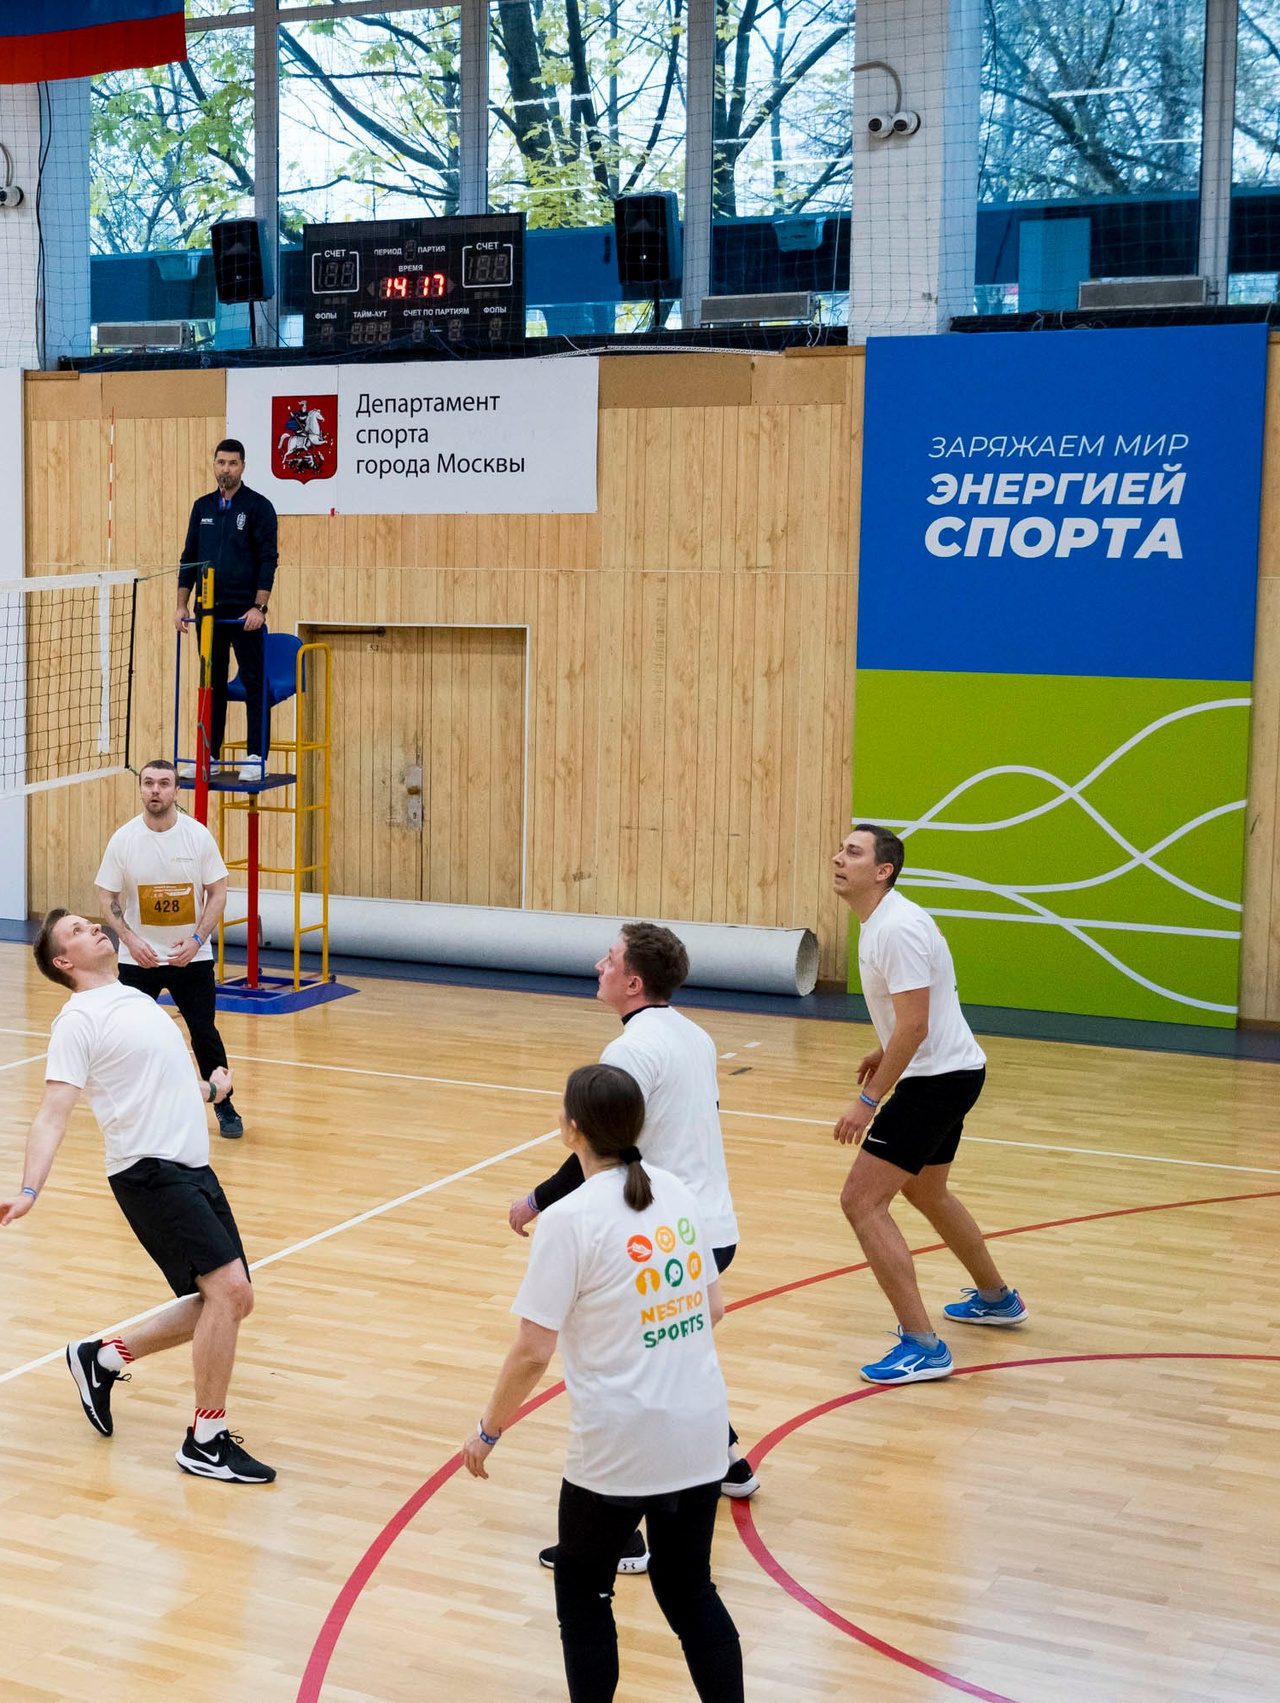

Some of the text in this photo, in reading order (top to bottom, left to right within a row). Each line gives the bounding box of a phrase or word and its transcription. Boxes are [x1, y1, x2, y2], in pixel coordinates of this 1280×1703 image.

[324, 249, 346, 258] СЧЕТ
[373, 245, 446, 256] ПЕРИОД ПАРТИЯ
[476, 241, 499, 250] СЧЕТ
[398, 264, 424, 273] ВРЕМЯ
[353, 309, 387, 319] ТАЙМ-АУТ
[403, 307, 470, 318] СЧЕТ ПО ПАРТИЯМ
[355, 393, 500, 418] Департамент
[355, 427, 429, 449] спорта
[928, 433, 1189, 459] ЗАРЯЖАЕМ МИР
[355, 453, 525, 480] города Москвы
[926, 463, 1187, 506] ЭНЕРГИЕЙ
[924, 516, 1184, 560] СПОРТА
[153, 899, 180, 913] 428
[640, 1290, 703, 1325] NESTRO
[643, 1313, 704, 1348] SPORTS
